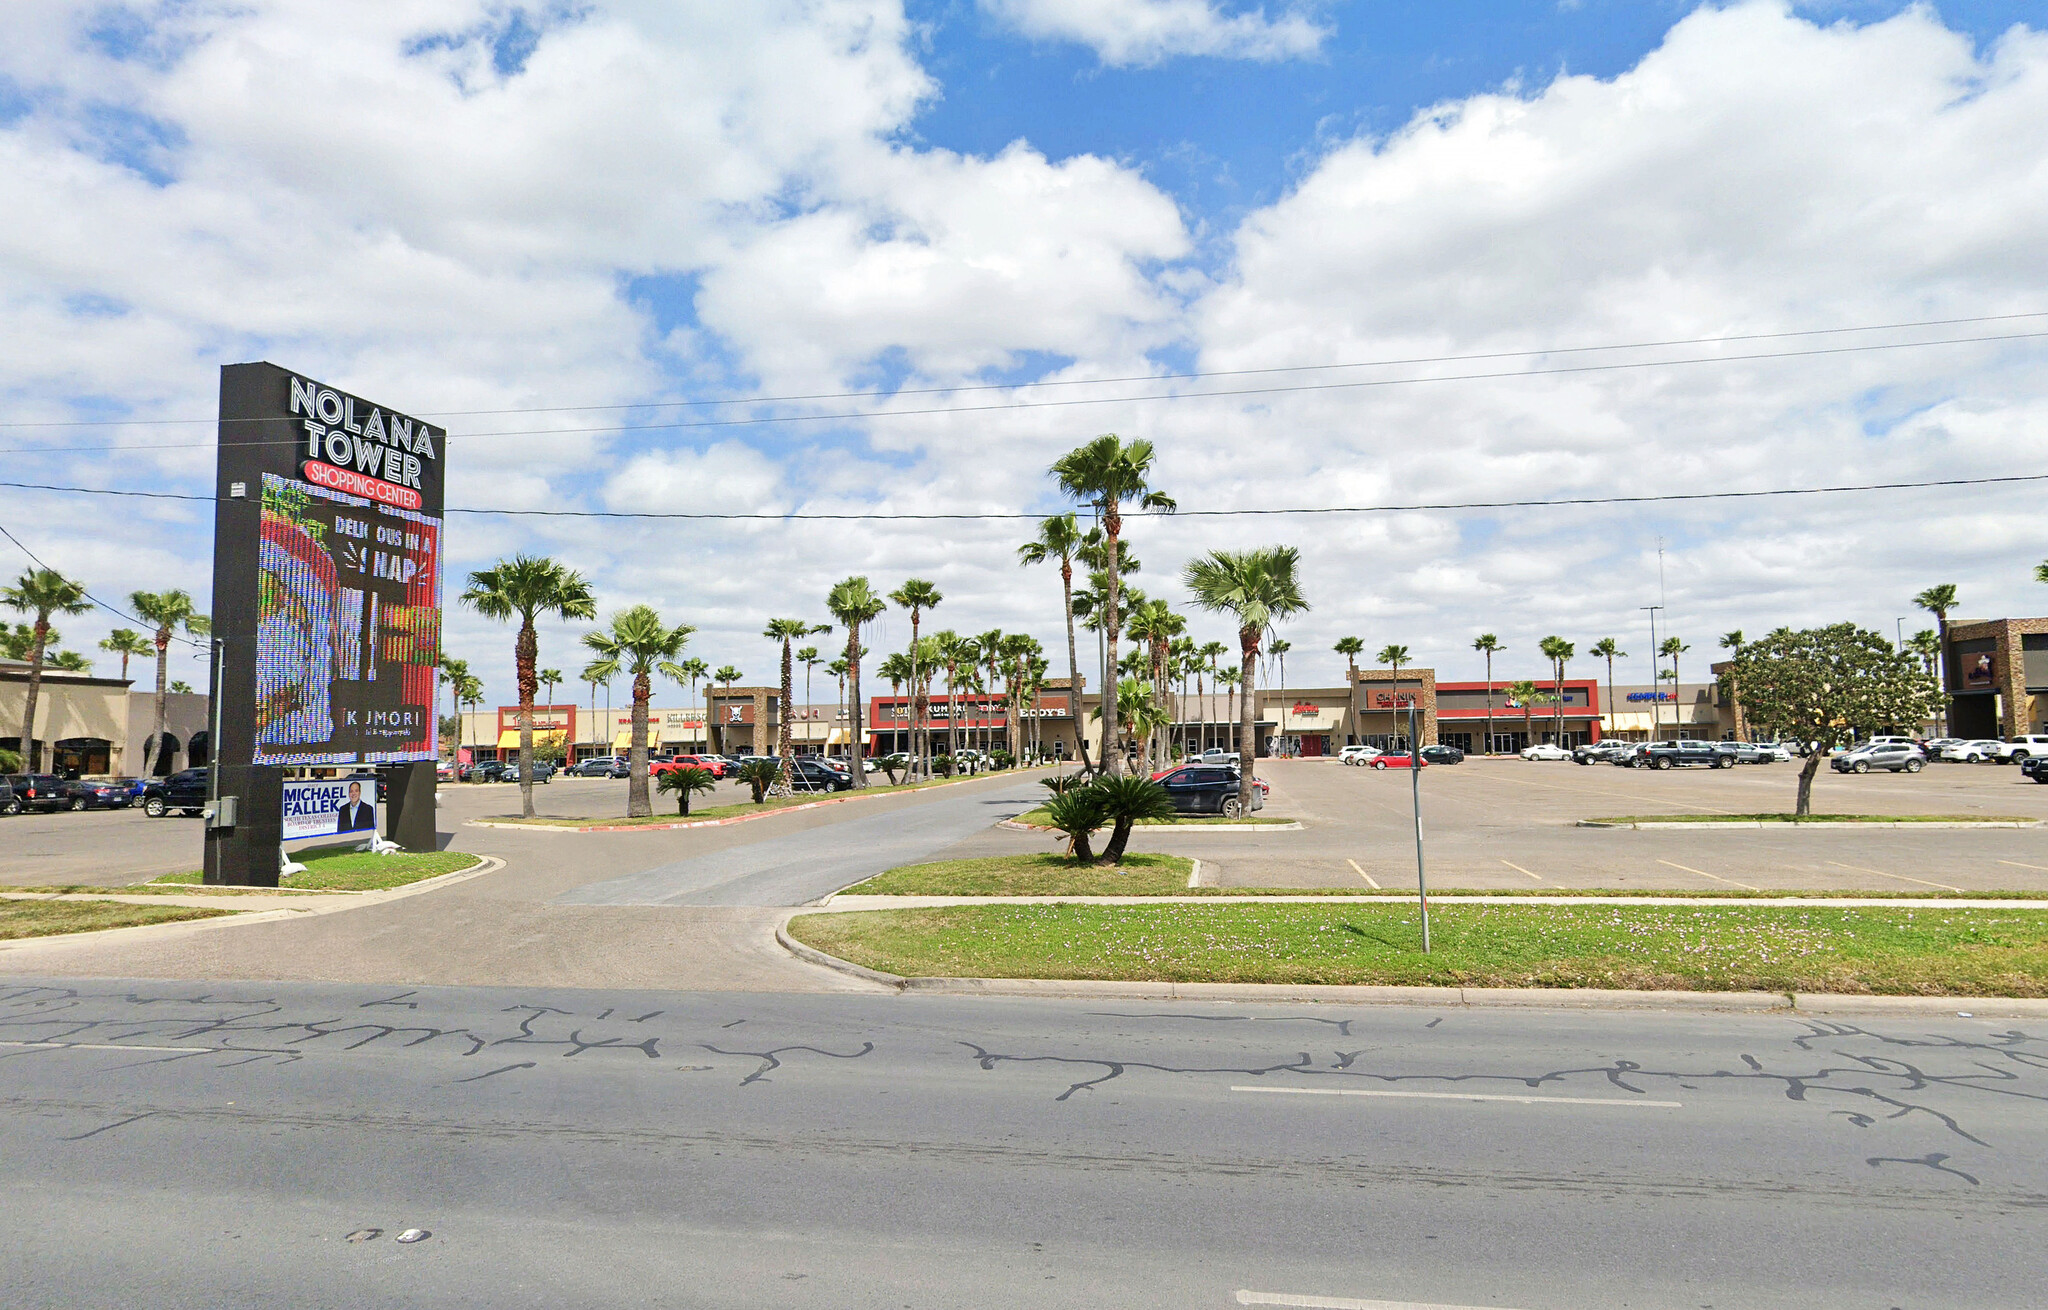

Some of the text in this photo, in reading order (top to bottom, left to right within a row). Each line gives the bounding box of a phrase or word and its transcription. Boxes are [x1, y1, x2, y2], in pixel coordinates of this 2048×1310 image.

[291, 377, 435, 459] NOLANA
[304, 420, 421, 489] TOWER
[311, 463, 416, 508] SHOPPING CENTER
[335, 515, 431, 554] DELIOUS IN A
[284, 786, 347, 802] MICHAEL
[284, 799, 340, 817] FALLEK
